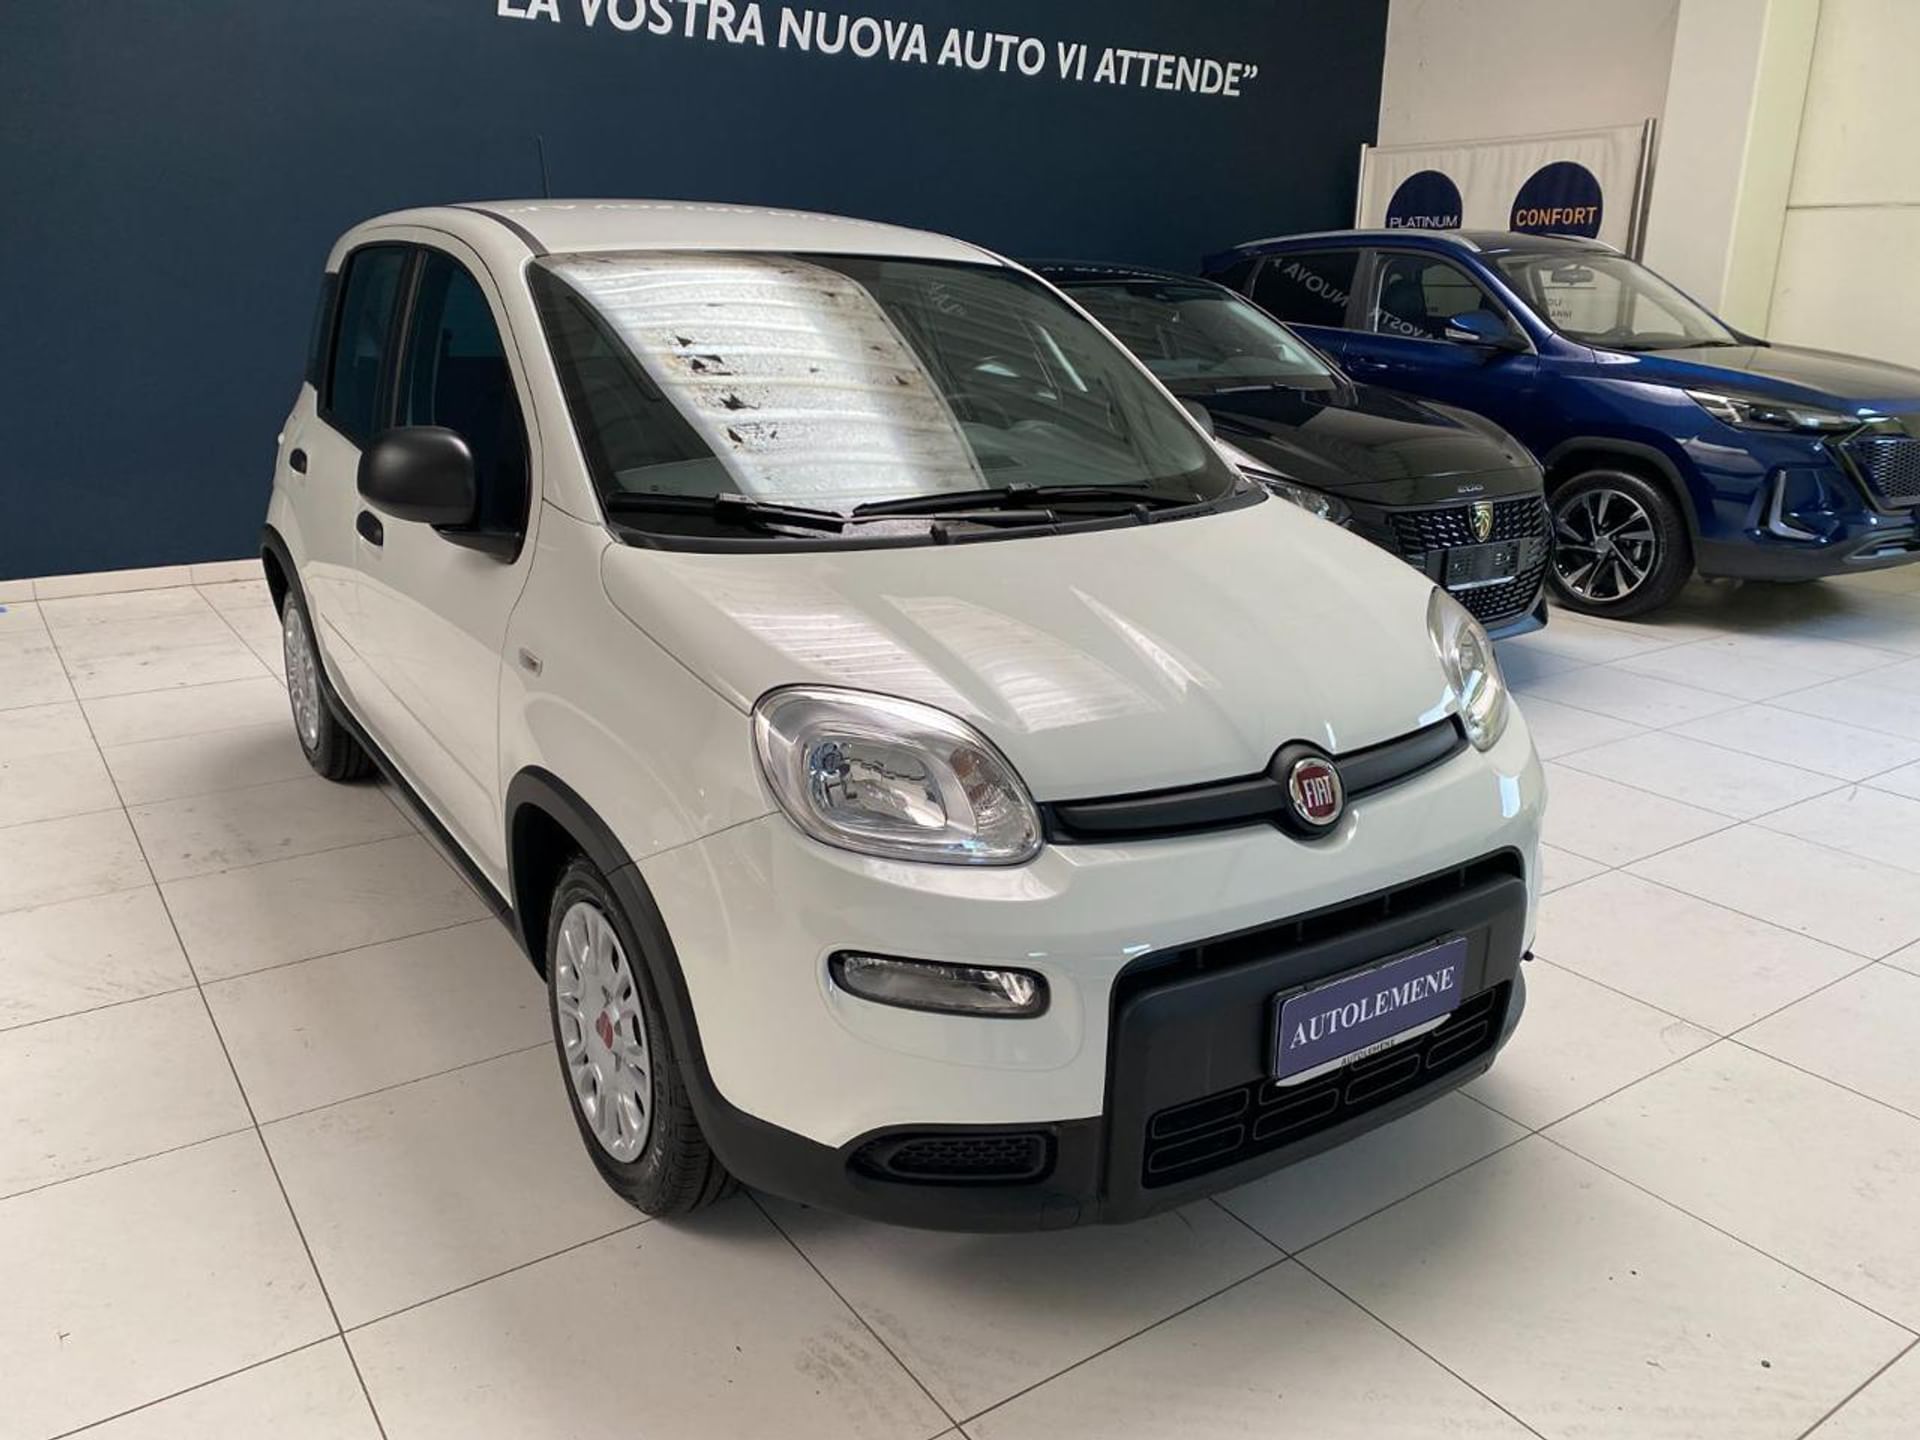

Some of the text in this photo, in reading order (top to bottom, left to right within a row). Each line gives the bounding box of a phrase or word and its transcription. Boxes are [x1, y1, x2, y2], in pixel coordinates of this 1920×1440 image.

[580, 0, 765, 46] VOSTRA
[778, 7, 927, 64] NUOVA
[937, 28, 1046, 75] AUTO
[1057, 41, 1087, 81] VI
[1390, 215, 1458, 228] PLATINUM
[1516, 206, 1597, 226] CONFORT
[1302, 775, 1333, 808] FIAT
[1290, 966, 1455, 1049] AUTOLEMENE
